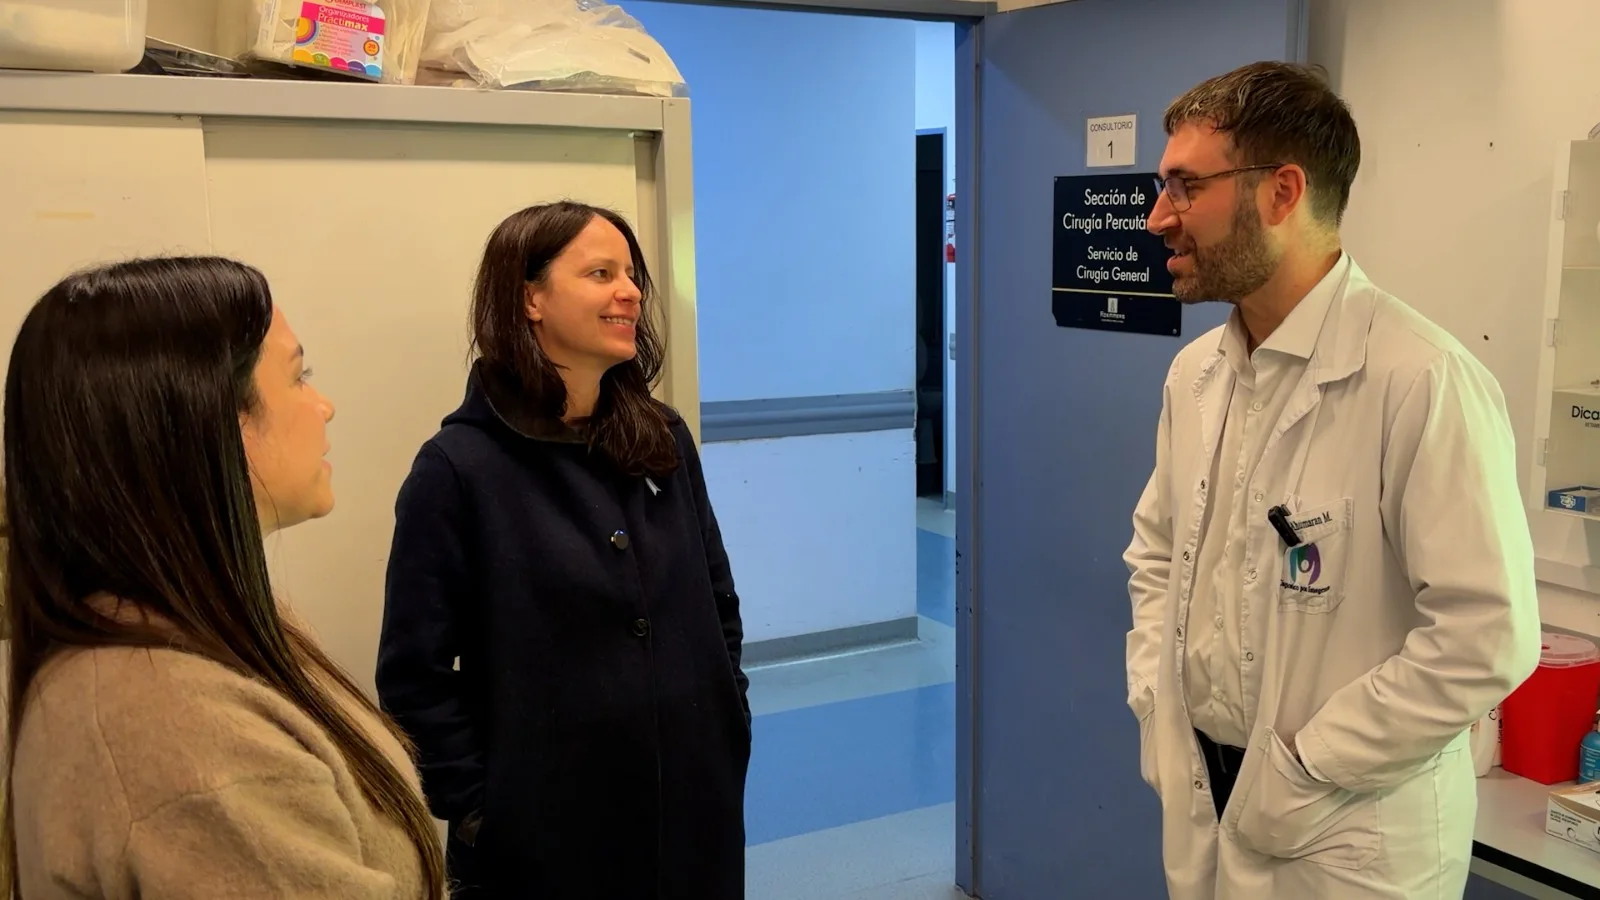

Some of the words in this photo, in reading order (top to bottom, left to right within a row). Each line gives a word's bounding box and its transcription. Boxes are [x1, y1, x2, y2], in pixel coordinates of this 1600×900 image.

[319, 6, 369, 22] Organizadores
[1090, 121, 1133, 132] CONSULTORIO
[1107, 140, 1113, 159] 1
[1084, 188, 1126, 205] Sección
[1130, 186, 1145, 205] de
[1063, 212, 1102, 234] Cirugía
[1105, 213, 1149, 230] Percutá
[1087, 246, 1124, 261] Servicio
[1126, 246, 1138, 261] de
[1076, 265, 1109, 284] Cirugía
[1111, 266, 1150, 283] General
